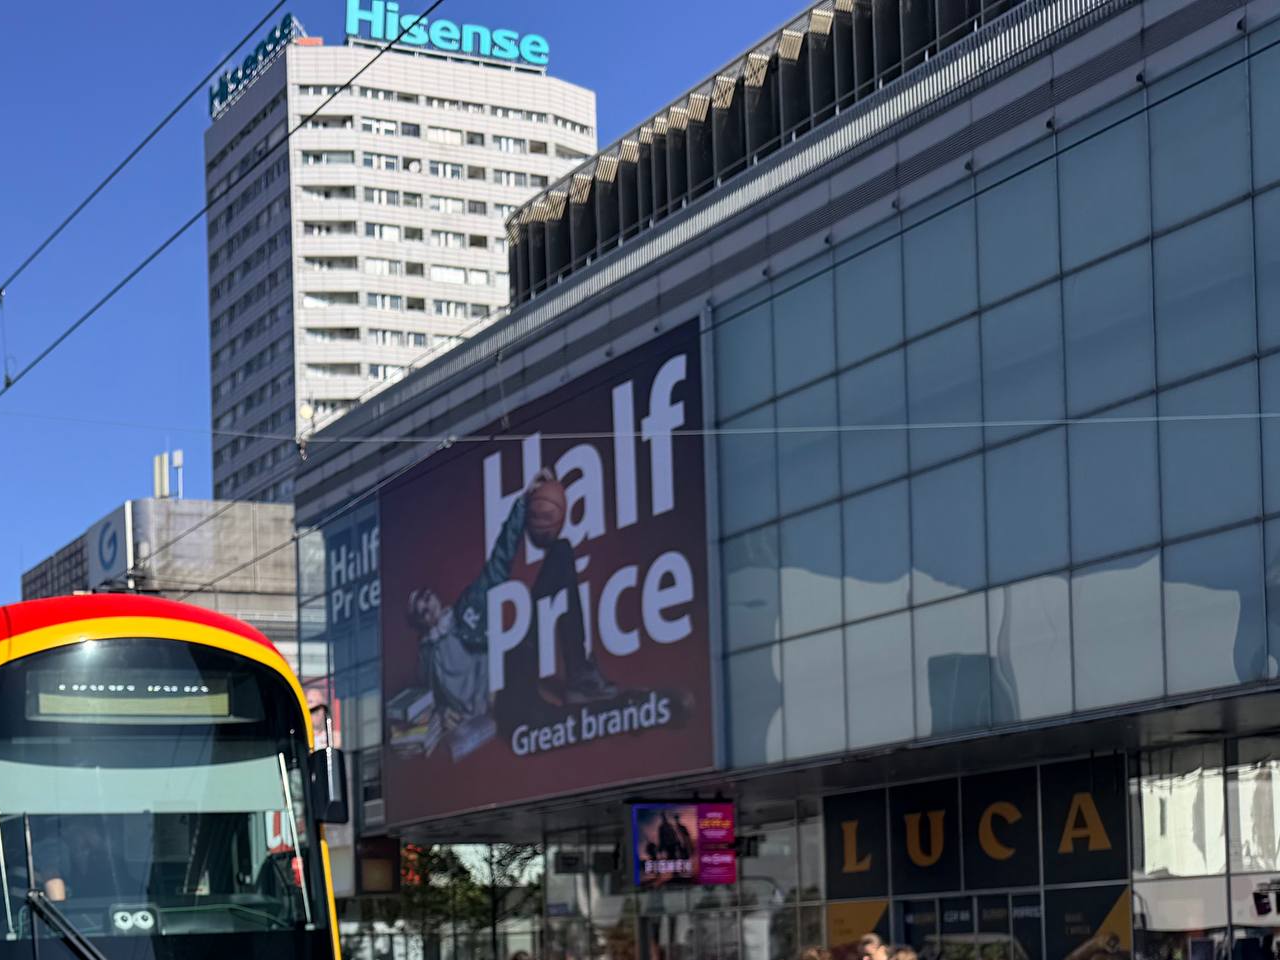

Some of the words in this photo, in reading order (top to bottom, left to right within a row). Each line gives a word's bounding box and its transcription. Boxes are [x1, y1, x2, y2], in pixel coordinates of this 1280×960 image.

[346, 0, 549, 65] Hisense
[483, 353, 688, 565] Half
[511, 720, 576, 757] Great
[580, 691, 671, 741] brands
[841, 791, 1112, 875] LUCA
